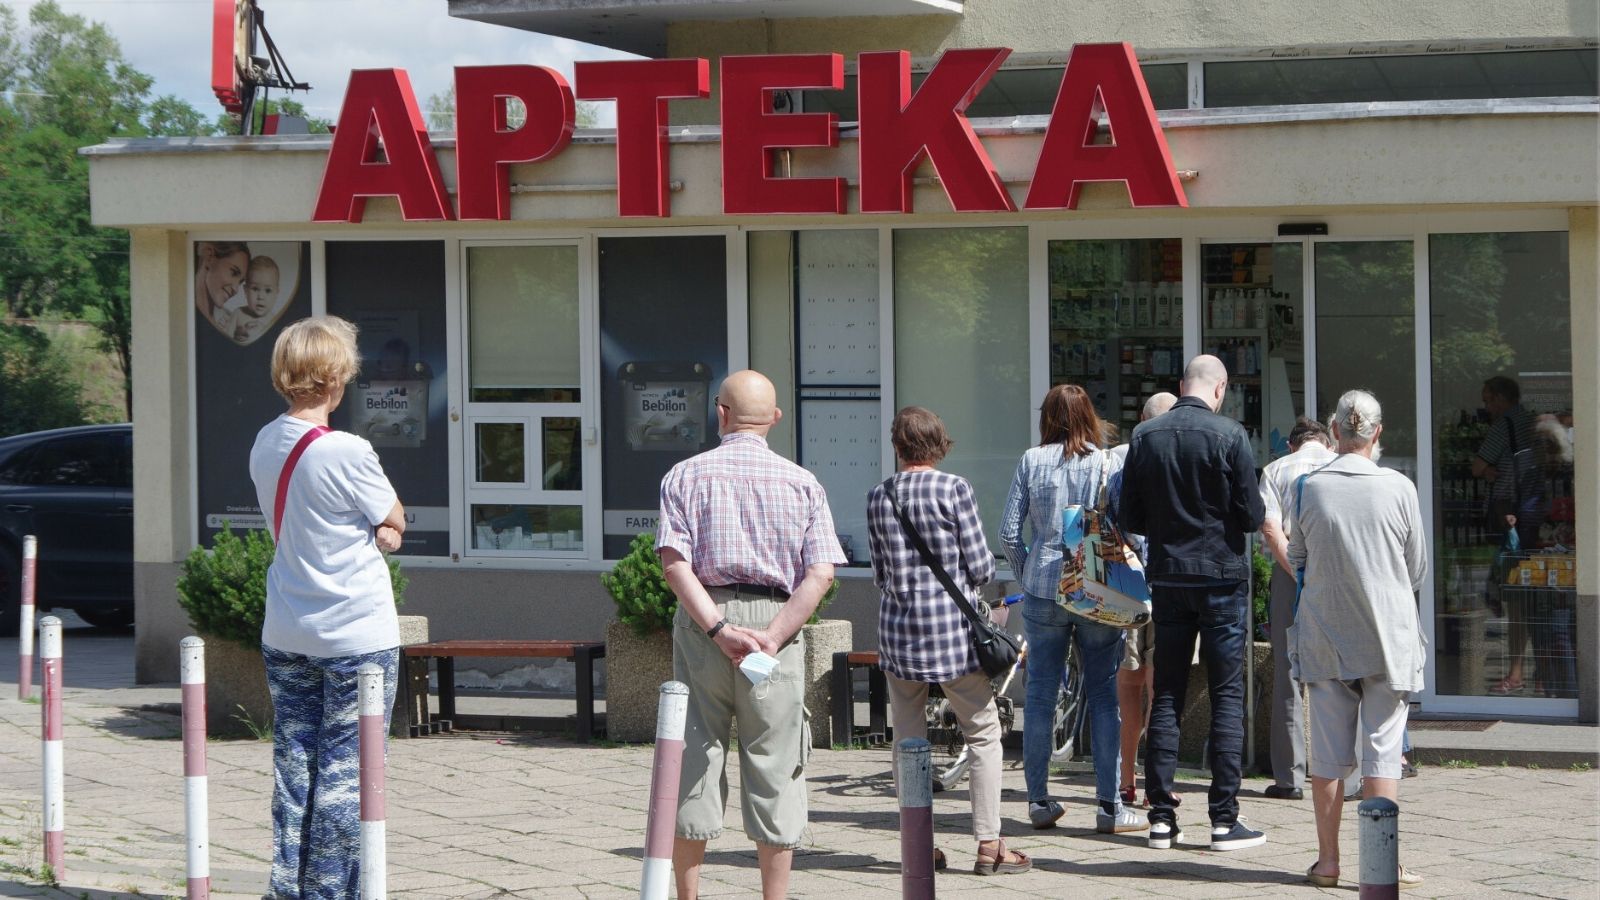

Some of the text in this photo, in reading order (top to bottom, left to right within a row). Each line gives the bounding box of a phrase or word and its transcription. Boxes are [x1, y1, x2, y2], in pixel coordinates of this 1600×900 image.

[312, 42, 1189, 222] APTEKA
[366, 397, 408, 409] Bebilon
[643, 399, 686, 412] Bebilon
